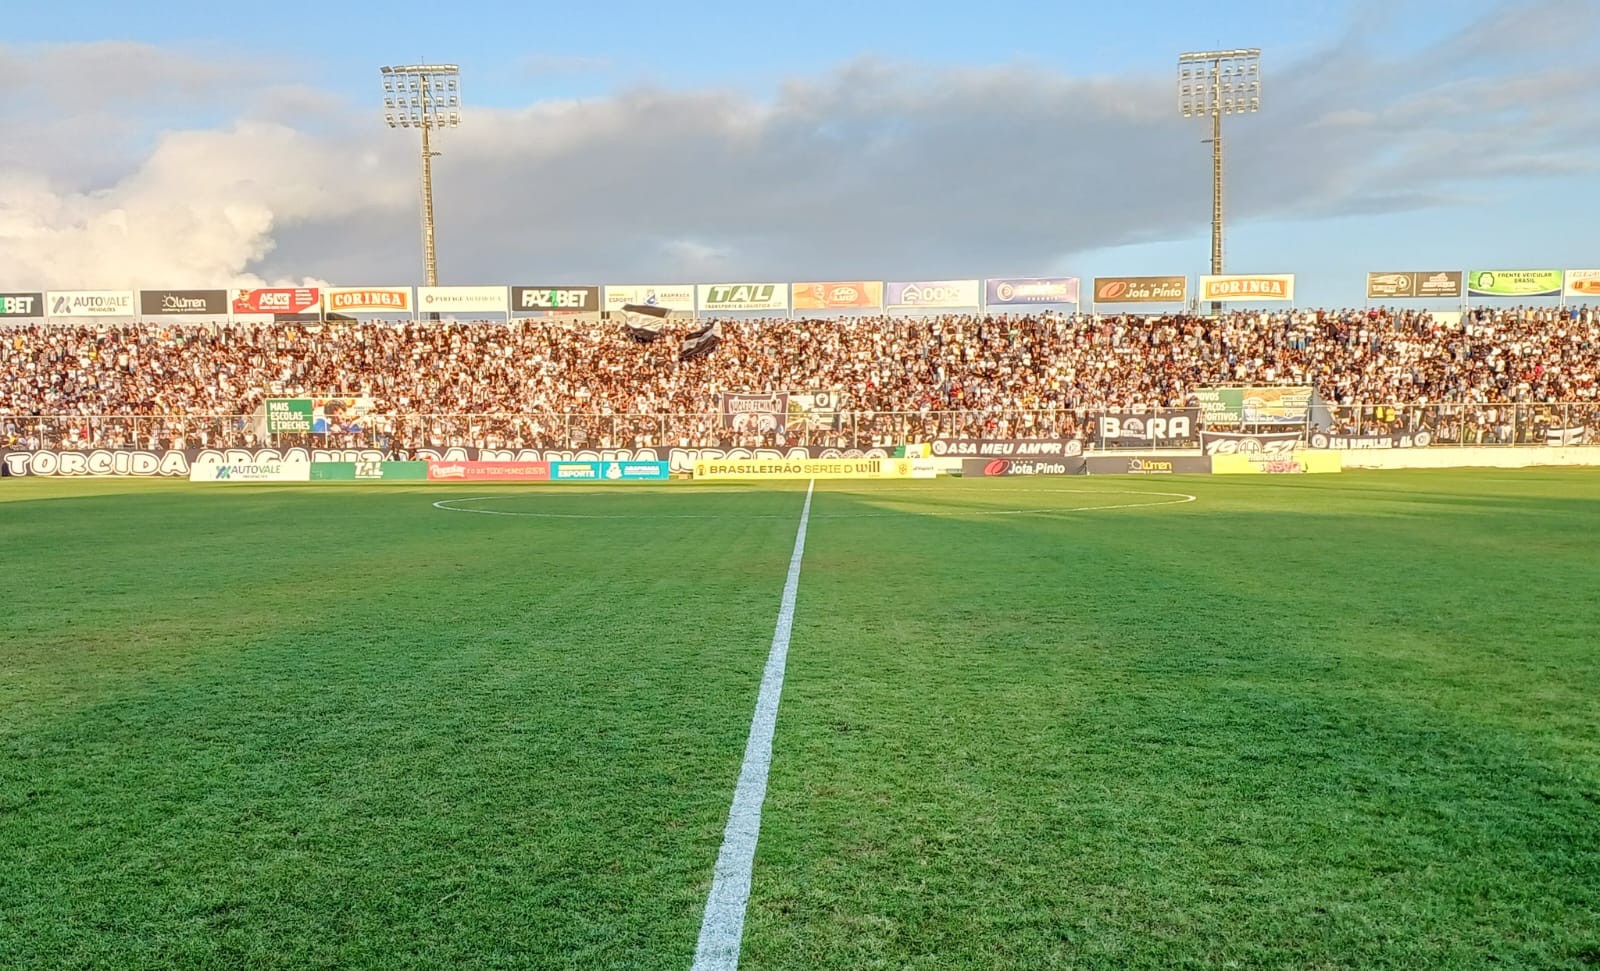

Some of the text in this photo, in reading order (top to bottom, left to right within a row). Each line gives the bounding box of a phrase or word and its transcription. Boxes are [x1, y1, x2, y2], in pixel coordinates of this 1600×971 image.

[1125, 287, 1182, 298] Jota Pinto
[1210, 280, 1282, 295] CORINGA
[73, 296, 129, 307] AUTOVALE
[335, 292, 402, 306] CORINGA
[269, 402, 289, 411] MAIS
[271, 412, 303, 420] ESCOLAS
[271, 420, 310, 430] E CRECHES
[947, 443, 977, 454] ASA
[980, 443, 1015, 454] MEU
[4, 450, 190, 476] TORCIDA
[709, 463, 801, 474] BRASILEIRÃO
[843, 464, 853, 474] D
[855, 460, 880, 473] will
[1008, 463, 1065, 474] Jota Pinto
[231, 466, 281, 474] AUTOVALE
[354, 462, 384, 476] TAL
